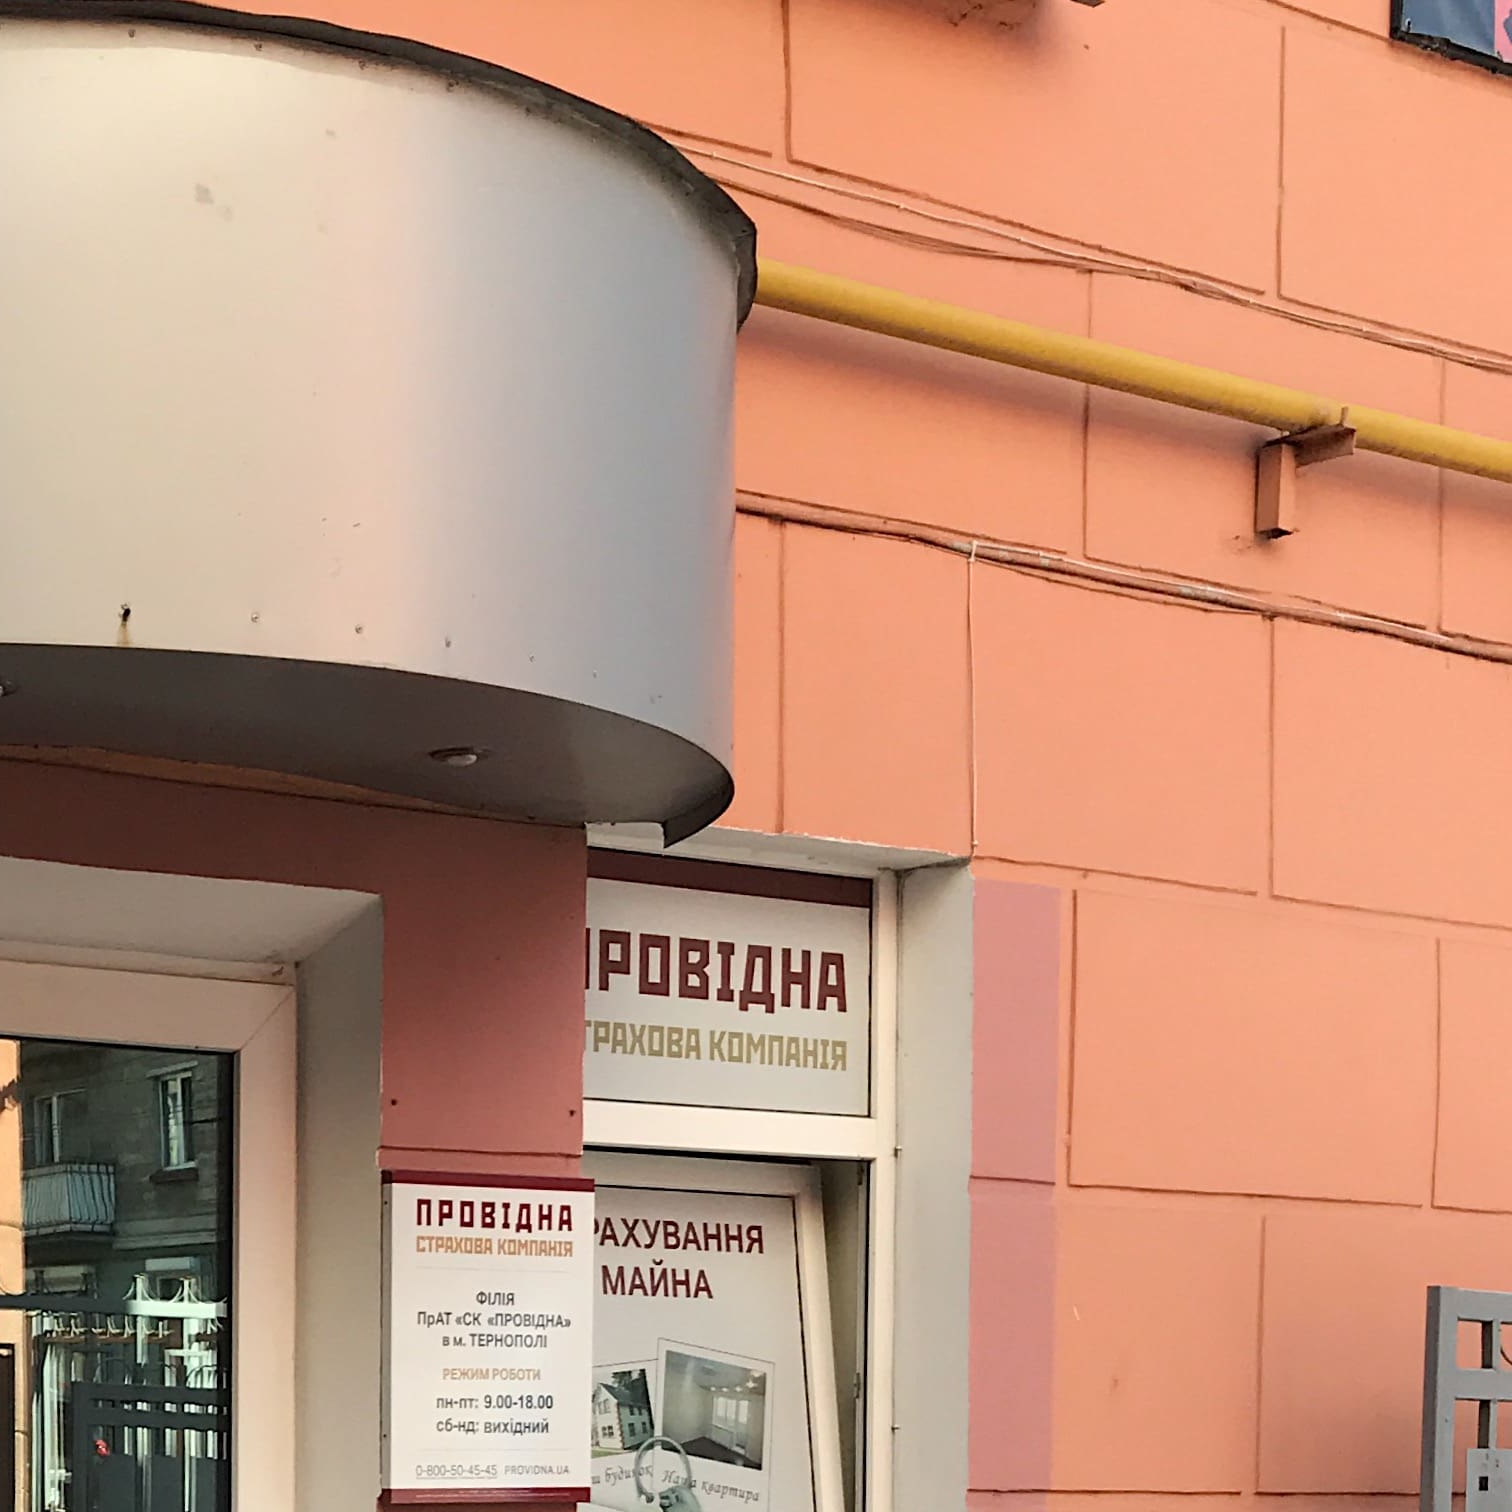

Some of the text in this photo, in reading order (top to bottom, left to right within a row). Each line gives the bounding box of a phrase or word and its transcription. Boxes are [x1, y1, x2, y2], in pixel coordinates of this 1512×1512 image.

[585, 927, 847, 1014] РОВІДНА
[709, 1030, 848, 1072] КОМПАНІЯ
[416, 1199, 573, 1233] ПРОВІДНА
[416, 1235, 573, 1257] СТРАХОВА КОМПАНІЯ
[601, 1259, 713, 1299] МАЙНА
[476, 1291, 515, 1306] ФІЛІЯ
[417, 1311, 571, 1330] ПрАТ «СК «ПРОВІДНА»
[442, 1334, 547, 1348] в м. ТЕРНОПОЛІ
[442, 1368, 541, 1382] РЕЖИМ РОБОТИ
[436, 1395, 553, 1410] пн-пт: 9.00-18.00
[436, 1418, 549, 1436] сб-нд: вихідний
[415, 1465, 570, 1478] 0-800-50-45-45 PROVIDNA.UA
